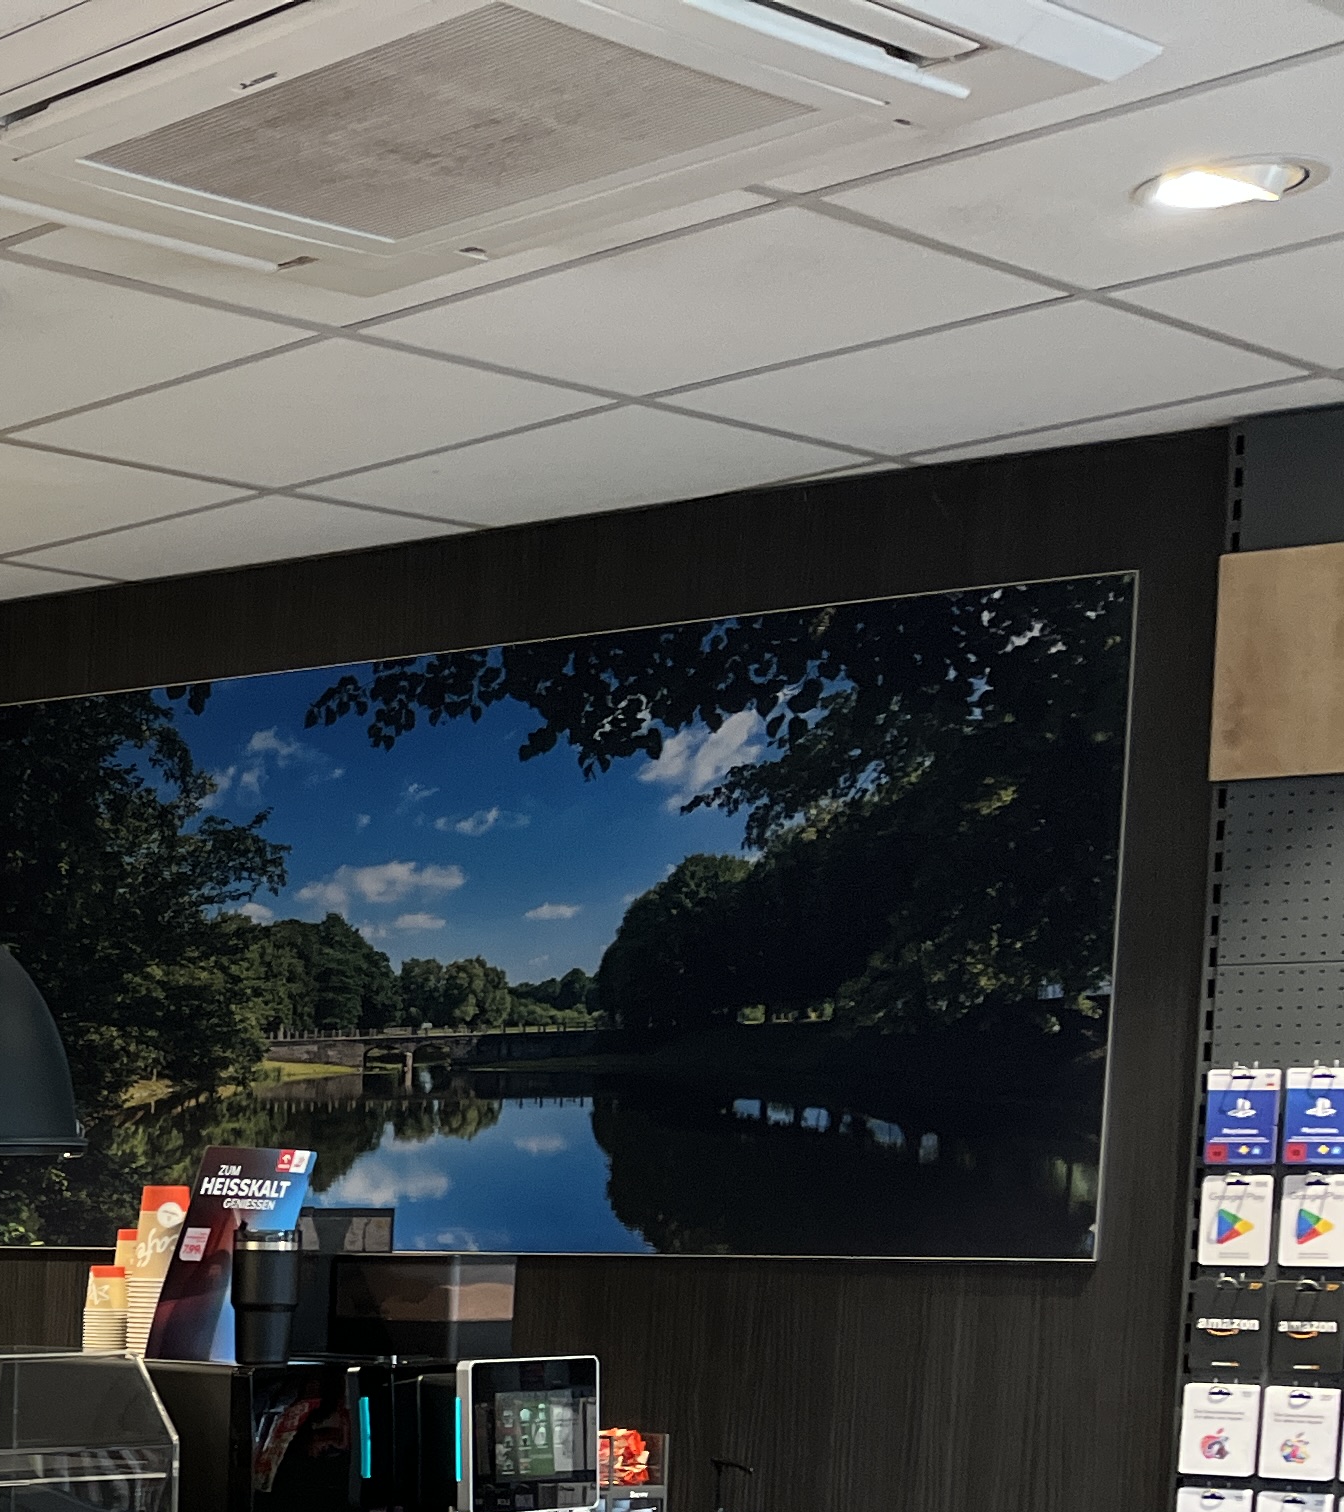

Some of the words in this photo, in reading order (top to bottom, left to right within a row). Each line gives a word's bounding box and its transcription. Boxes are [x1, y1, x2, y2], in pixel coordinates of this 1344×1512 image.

[218, 1164, 242, 1176] ZUM
[200, 1177, 291, 1199] HEISSKALT
[222, 1198, 276, 1211] GENIESSEN
[1196, 1317, 1260, 1331] amazon
[1277, 1320, 1338, 1333] amazon
